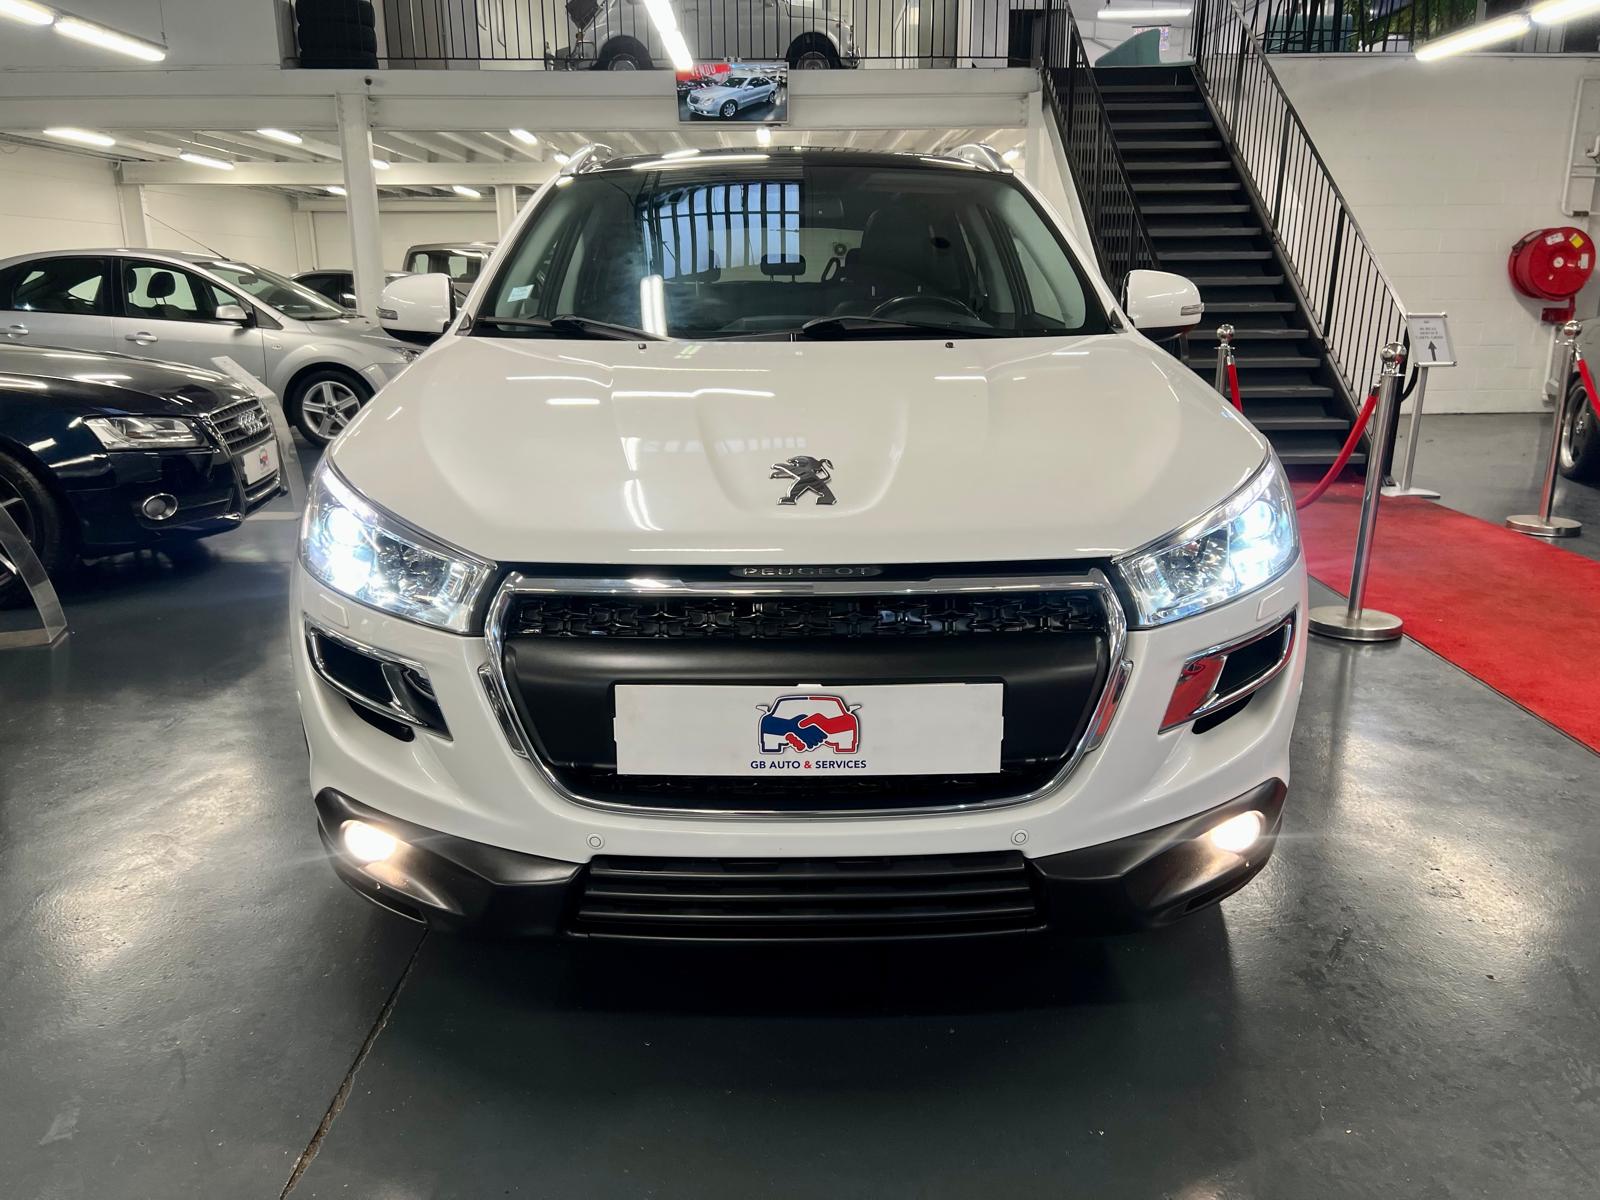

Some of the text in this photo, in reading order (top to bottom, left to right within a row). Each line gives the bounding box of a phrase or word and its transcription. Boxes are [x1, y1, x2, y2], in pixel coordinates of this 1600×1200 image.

[690, 64, 716, 78] VENDU
[744, 567, 869, 576] PEUGEOT
[750, 760, 867, 769] GB AUTO & SERVICES
